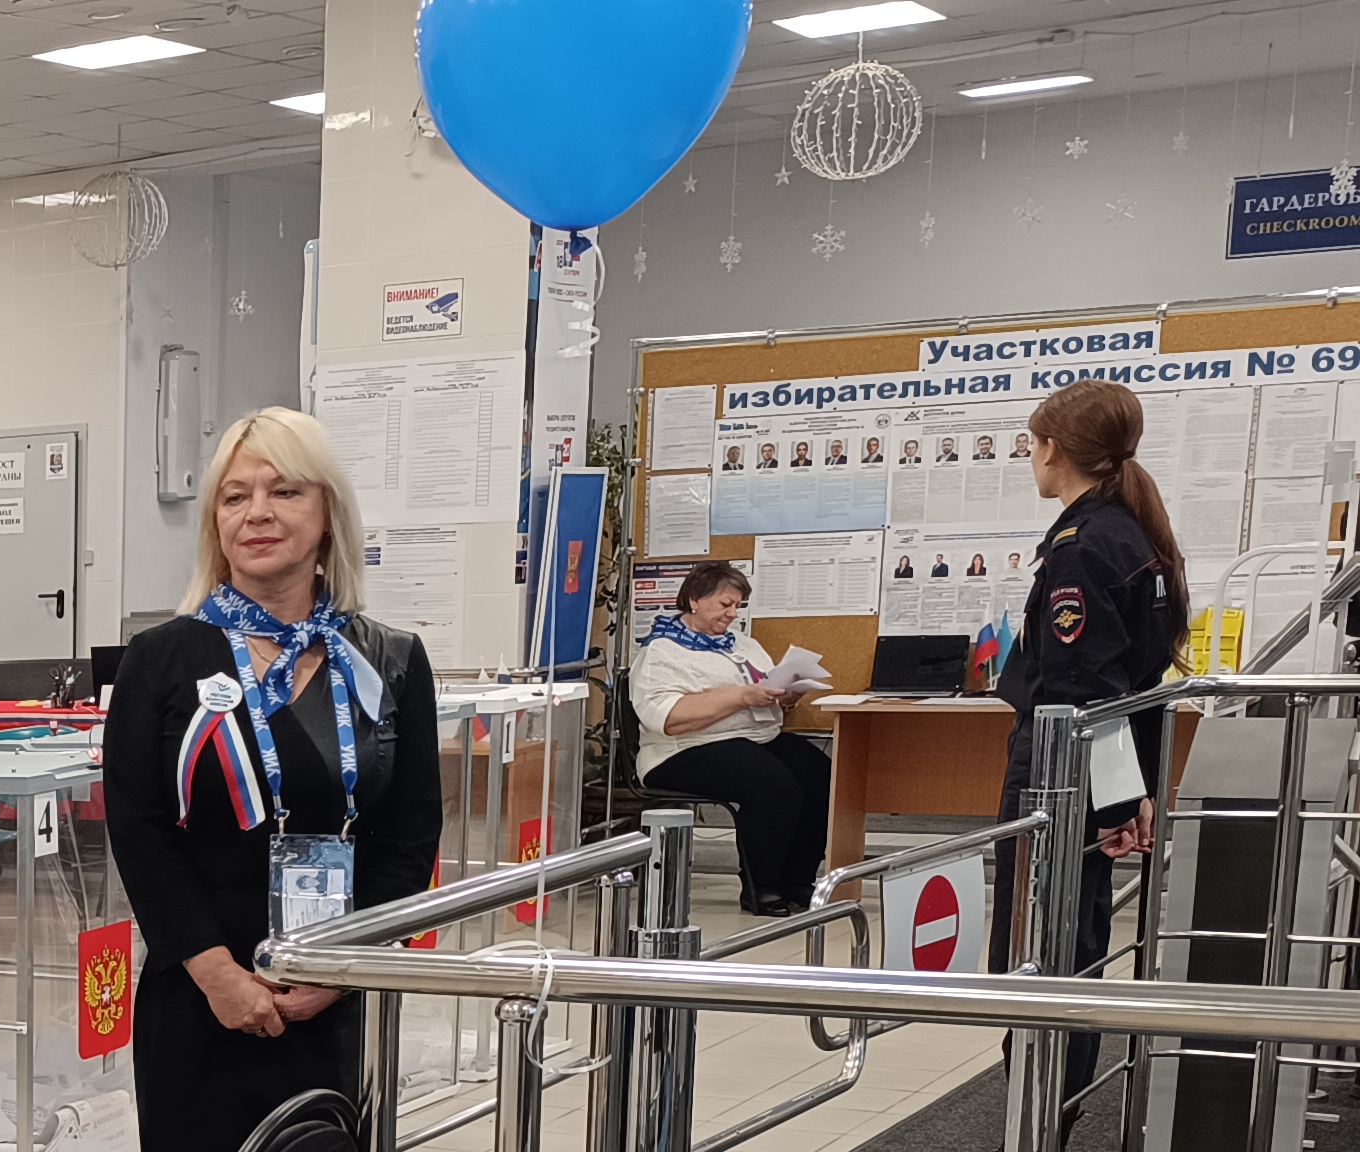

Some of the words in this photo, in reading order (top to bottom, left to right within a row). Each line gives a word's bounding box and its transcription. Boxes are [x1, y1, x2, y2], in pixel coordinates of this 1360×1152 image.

[1246, 215, 1360, 235] CHECKROOM
[387, 287, 439, 302] ВНИМАНИЕ!
[927, 330, 1153, 364] Участковая
[729, 373, 1011, 409] избирательная
[1030, 360, 1231, 389] комиссия
[1247, 350, 1295, 376] №
[505, 720, 511, 754] 1
[261, 747, 281, 778] УИК
[340, 743, 357, 774] УИК
[38, 800, 53, 843] 4
